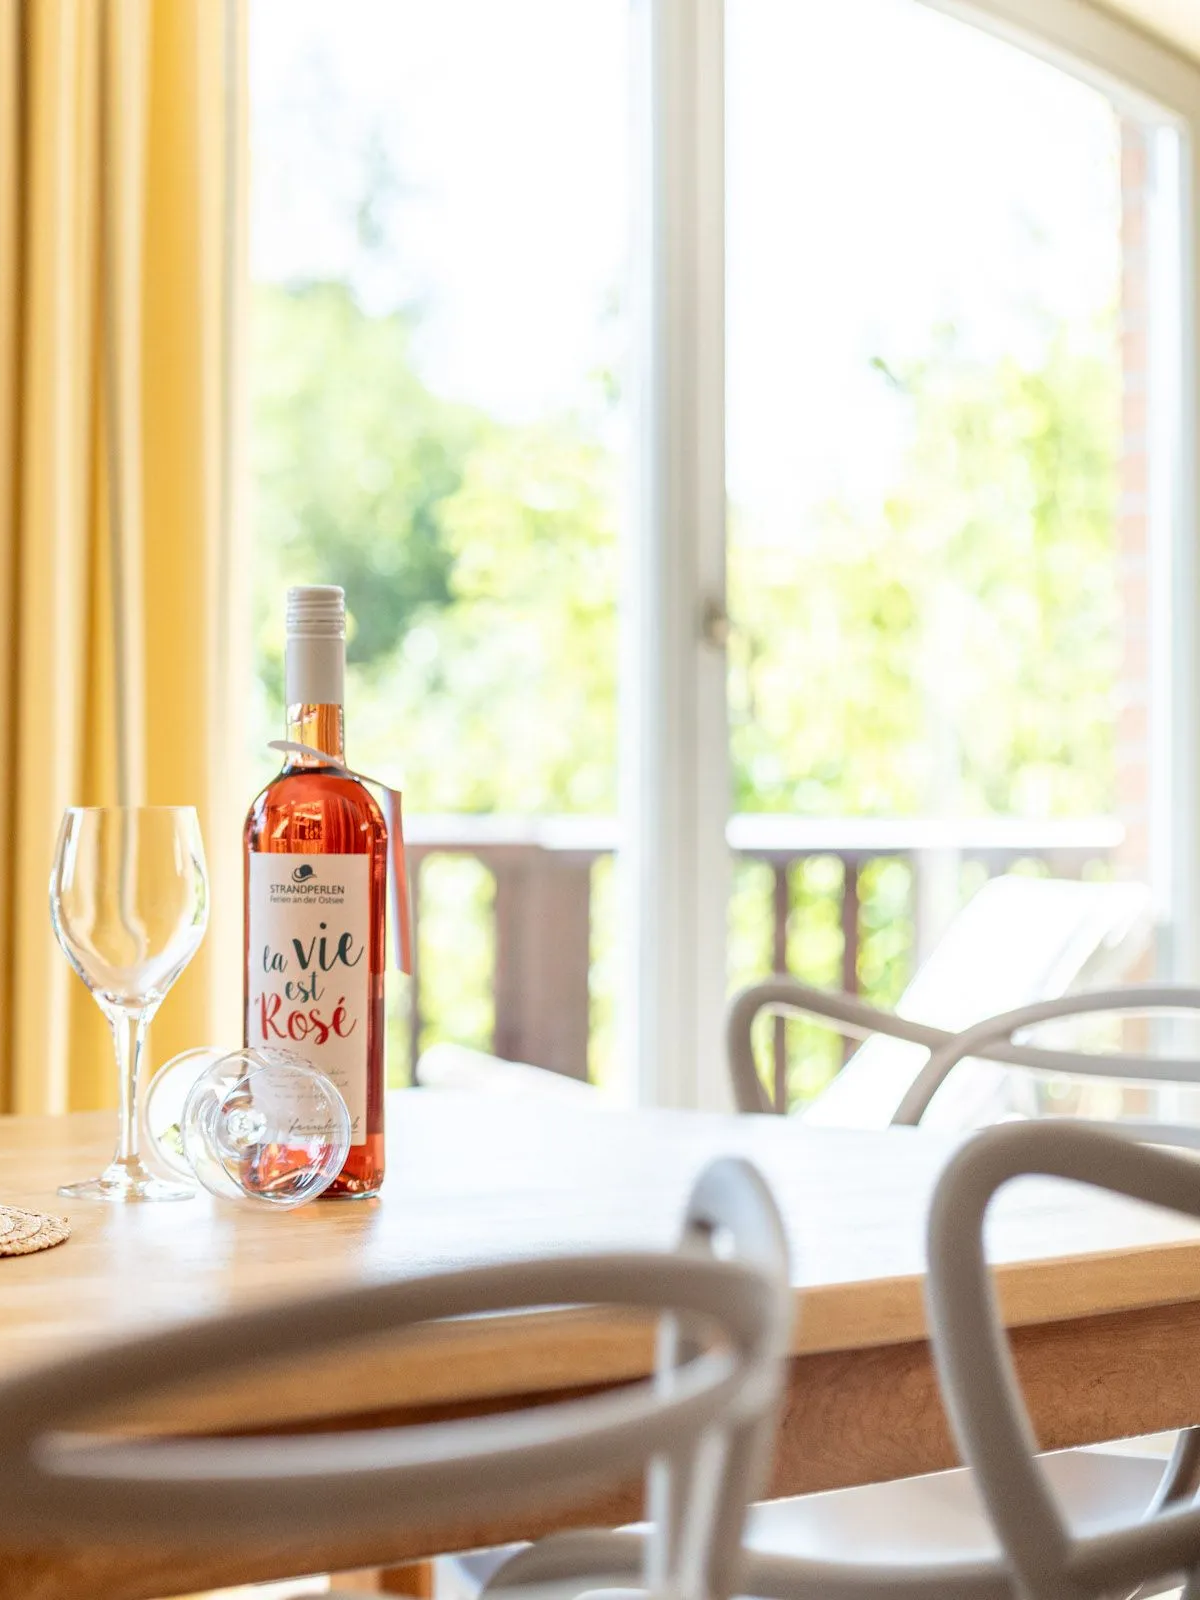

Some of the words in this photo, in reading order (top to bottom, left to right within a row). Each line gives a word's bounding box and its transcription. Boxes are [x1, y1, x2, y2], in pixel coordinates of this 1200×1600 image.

[270, 884, 345, 894] STRANDPERLEN
[270, 895, 291, 904] Ferien
[303, 896, 316, 905] der
[318, 896, 345, 905] Ostsee
[263, 945, 288, 973] la
[292, 922, 364, 972] vie
[285, 971, 325, 1003] est
[255, 992, 357, 1045] Rosé
